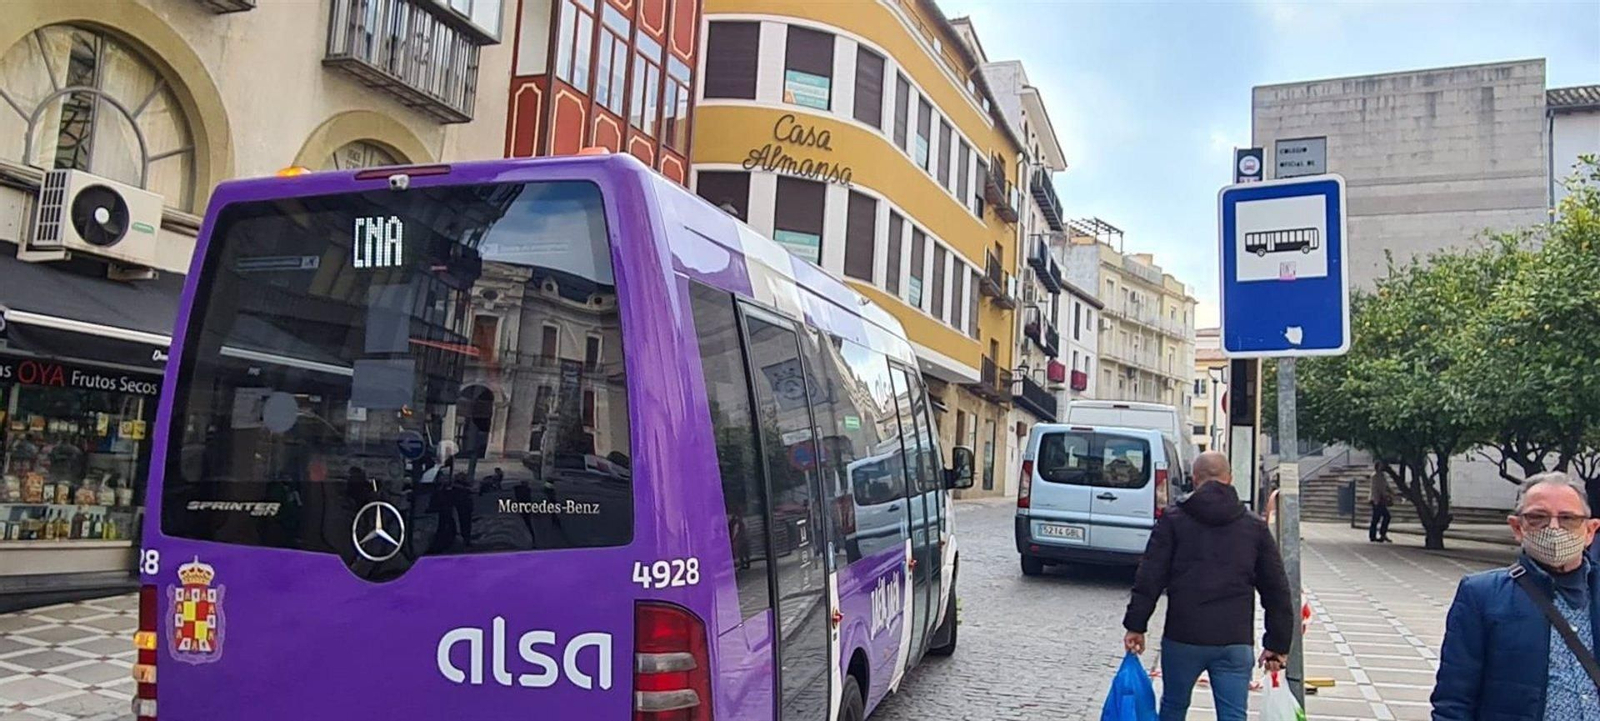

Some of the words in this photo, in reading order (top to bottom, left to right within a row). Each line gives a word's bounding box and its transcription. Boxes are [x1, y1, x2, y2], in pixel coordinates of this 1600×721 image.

[773, 114, 833, 152] Casa
[743, 143, 853, 189] Almansa
[18, 360, 65, 387] OYA
[71, 370, 116, 391] Frutos
[119, 376, 158, 395] Secos
[186, 501, 281, 511] SPRINTER
[498, 498, 601, 515] Mercedes-Benz
[632, 557, 701, 590] 4928
[437, 616, 613, 691] alsa
